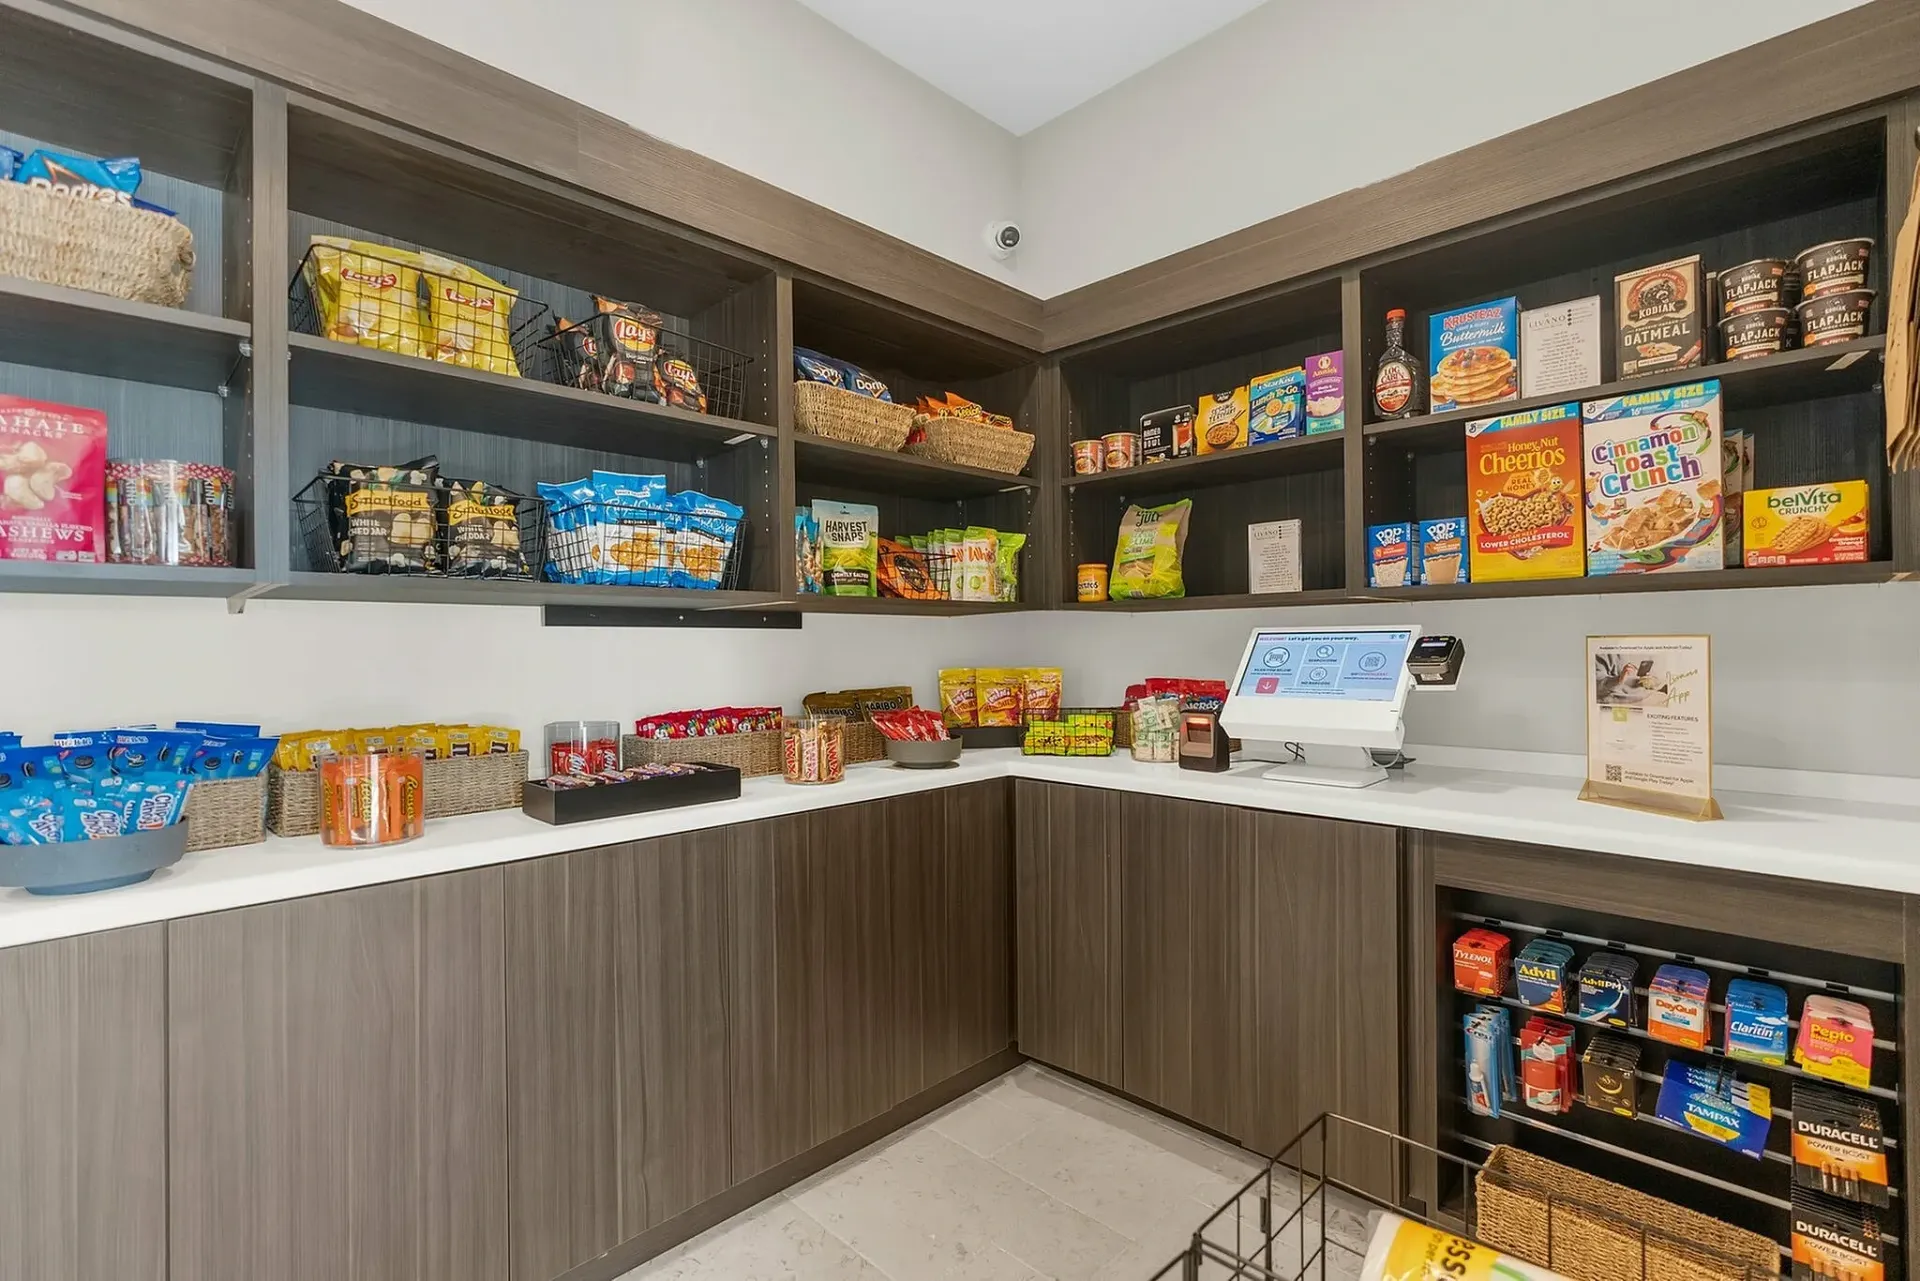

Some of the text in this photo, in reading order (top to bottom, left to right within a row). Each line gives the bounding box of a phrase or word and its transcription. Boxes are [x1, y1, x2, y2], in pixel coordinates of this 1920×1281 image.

[1807, 261, 1864, 281] FLAPJACK
[1726, 279, 1778, 299] FLAPJACK
[1444, 308, 1503, 330] KRUSTEAZ
[1638, 302, 1676, 319] KODIAK
[1807, 312, 1863, 331] FLAPJACK
[1440, 322, 1505, 346] Buttermilk
[1624, 322, 1690, 346] OATMEAL
[1729, 328, 1780, 346] FLAPJACK
[1384, 366, 1399, 375] LOG
[1262, 376, 1294, 388] StarKist
[1252, 392, 1276, 408] Lunch
[1622, 384, 1704, 407] FAMILY SIZE
[1500, 408, 1566, 428] FAMILY SIZE
[1508, 437, 1558, 452] Honey Nut
[1595, 426, 1697, 461] Cinnamon
[1480, 448, 1566, 475] Cheerios
[1614, 444, 1679, 474] Toast
[1512, 476, 1532, 484] REAL
[1604, 456, 1700, 495] Crunch
[204, 478, 215, 505] KIND
[1507, 482, 1536, 491] HONEY
[350, 494, 421, 508] Smartfood
[1768, 488, 1842, 508] belVita
[1779, 505, 1829, 515] CRUNCHY
[825, 520, 867, 533] HARVEST
[831, 532, 864, 542] SNAPS
[1510, 532, 1569, 545] CHOLESTEROL
[785, 738, 797, 774] TWIX
[826, 738, 838, 776] TWIX
[1455, 949, 1493, 964] TYLENOL
[1519, 964, 1556, 980] Advil
[1581, 977, 1620, 990] Advil PM
[1656, 999, 1698, 1016] DayQuil
[1465, 1027, 1493, 1041] Crest
[1730, 1021, 1773, 1037] Claritin
[1810, 1024, 1855, 1042] Pepto
[1686, 1102, 1740, 1129] TAMPAX
[1798, 1120, 1878, 1148] DURACELL
[1807, 1140, 1871, 1160] POWER BOOST
[1796, 1221, 1877, 1257] DURACELL
[1804, 1240, 1868, 1266] POWER BOOST
